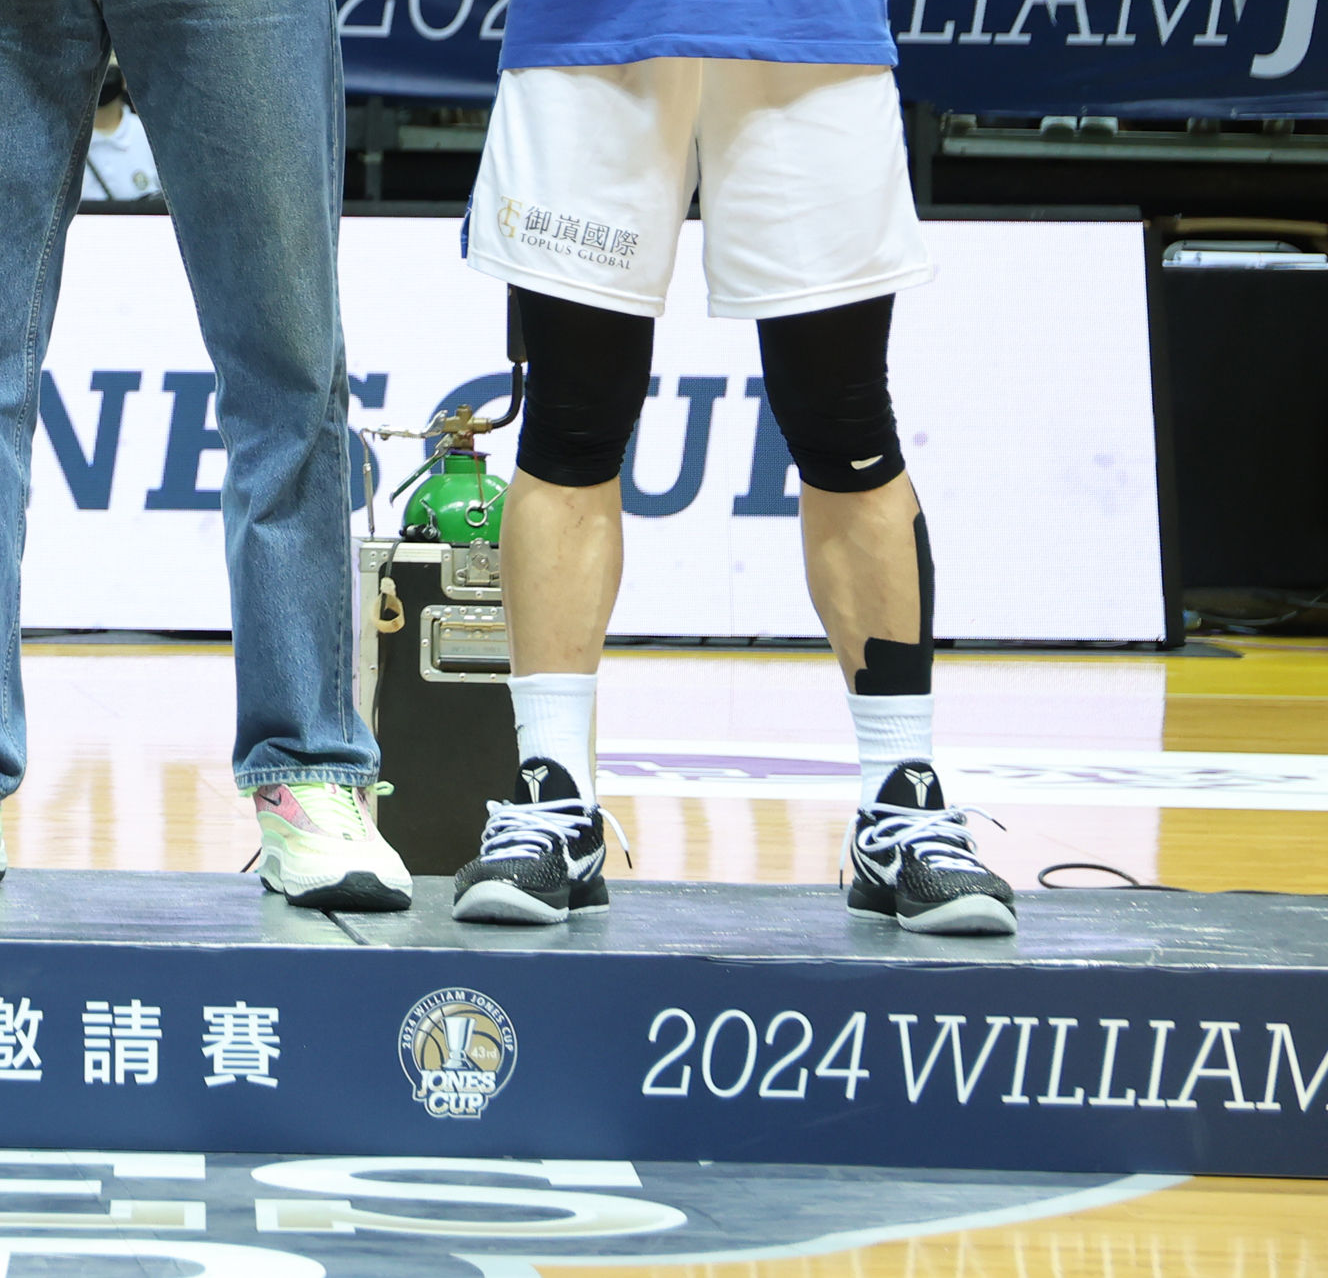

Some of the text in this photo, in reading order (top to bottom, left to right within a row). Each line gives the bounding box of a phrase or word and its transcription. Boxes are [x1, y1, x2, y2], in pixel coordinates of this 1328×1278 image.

[519, 233, 632, 271] TOPLUS GLOBAL
[402, 990, 514, 1053] 2024 WILLIAM JONES CUP
[470, 1045, 498, 1060] 43rd
[641, 1006, 870, 1101] 2024
[416, 1069, 497, 1098] JONES
[427, 1091, 485, 1115] CUP
